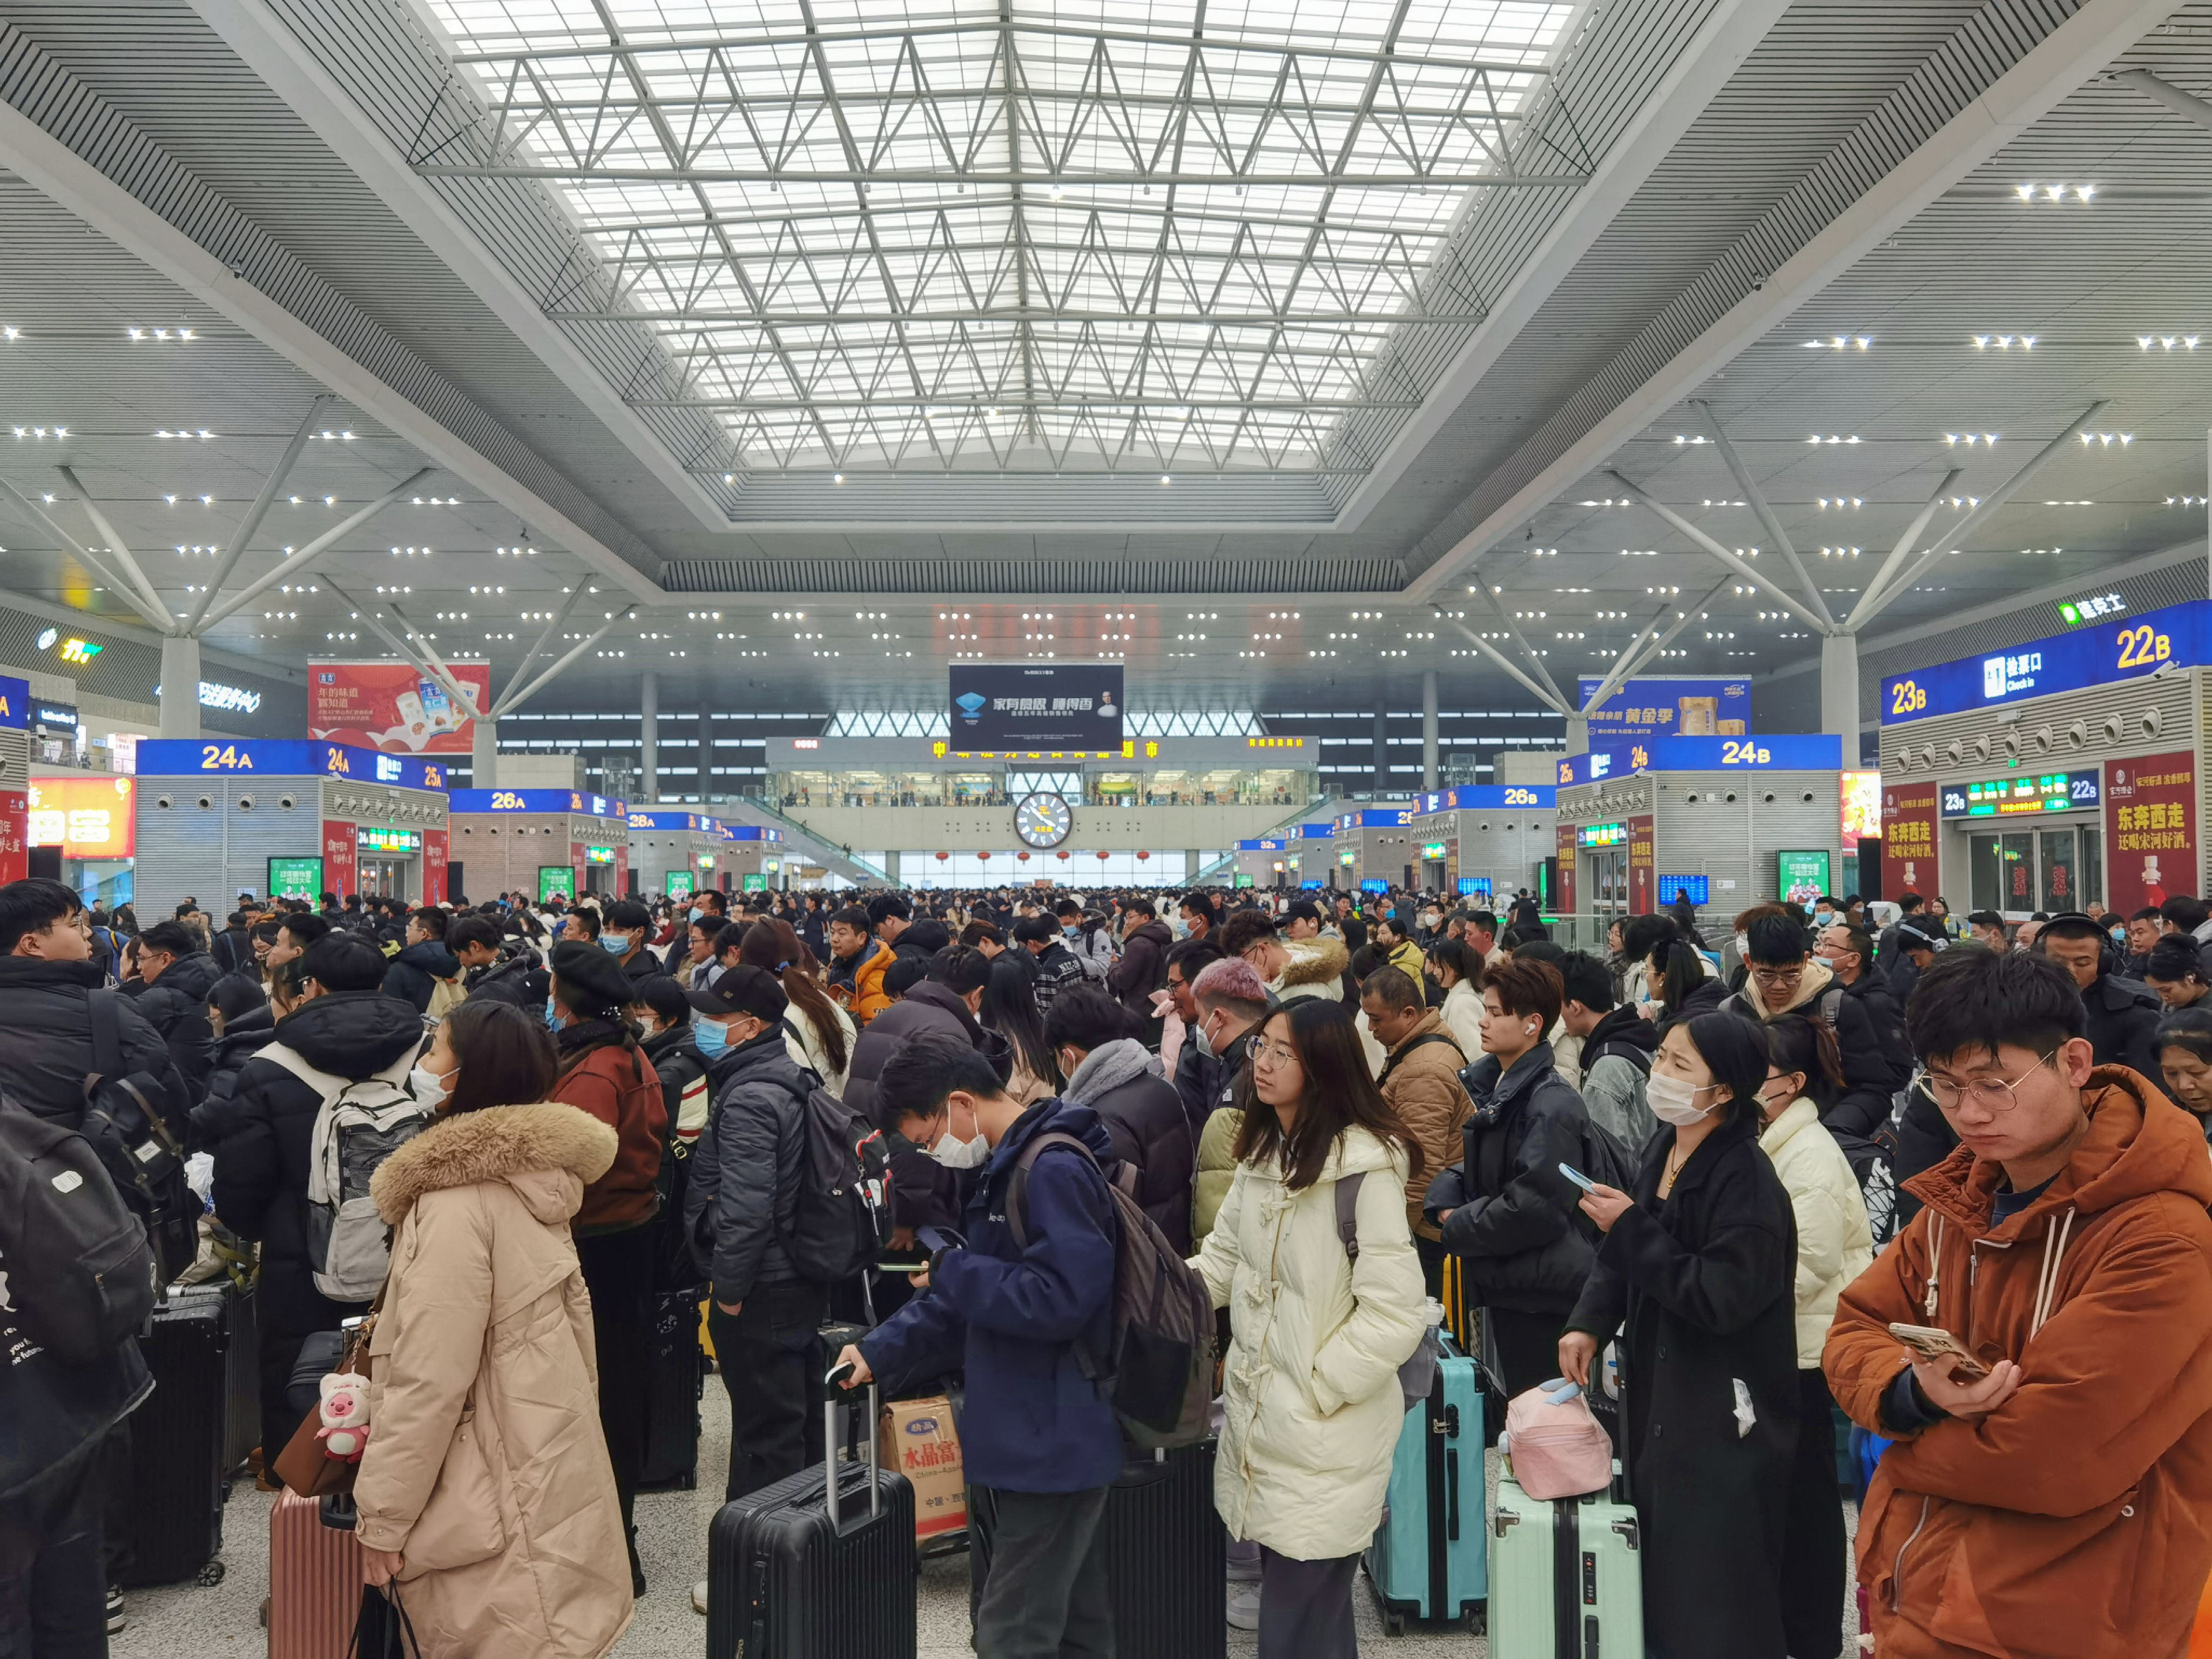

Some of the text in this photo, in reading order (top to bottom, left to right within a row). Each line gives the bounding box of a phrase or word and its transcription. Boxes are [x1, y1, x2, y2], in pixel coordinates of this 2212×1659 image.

[2117, 625, 2171, 669] 22B
[2007, 652, 2041, 677] 检票口
[2007, 679, 2026, 692] Check
[993, 698, 1093, 710] 家有慕思 睡得香
[1892, 680, 1926, 714] 23B
[1625, 708, 1673, 724] 黄金季
[201, 745, 253, 769] 24A
[328, 748, 350, 773] 24A
[1631, 745, 1648, 768] 24B
[1722, 741, 1771, 764] 24B
[424, 766, 442, 787] 25A
[1560, 764, 1573, 783] 25B
[1505, 788, 1538, 805] 26B
[2072, 780, 2096, 799] 22B
[491, 792, 526, 809] 26A
[1945, 793, 1965, 811] 23B
[629, 814, 655, 827] 28A
[2117, 802, 2185, 831] 东奔西走
[1889, 821, 1931, 842] 东奔西走
[2118, 831, 2191, 851] 还喝宋河好酒。
[902, 1440, 961, 1469] 水晶富
